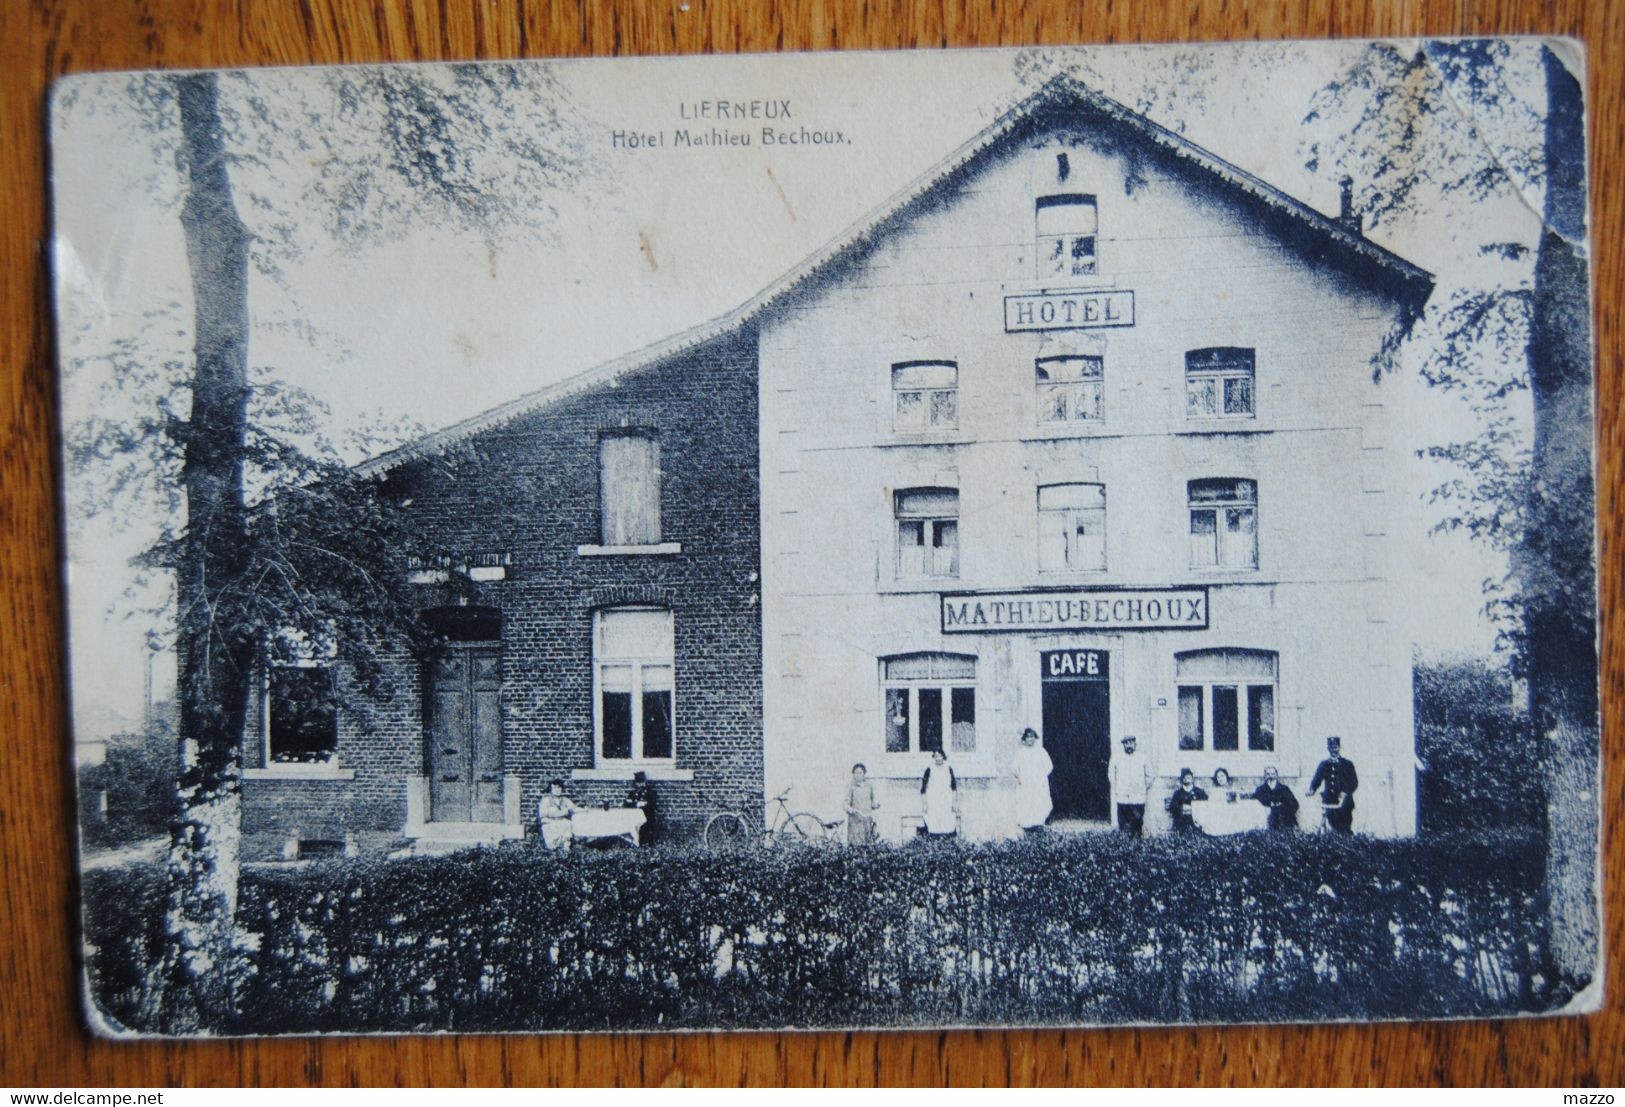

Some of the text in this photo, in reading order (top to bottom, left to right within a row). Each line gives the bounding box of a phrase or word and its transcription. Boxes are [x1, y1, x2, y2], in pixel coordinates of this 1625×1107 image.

[680, 100, 792, 119] LIERNEUX
[612, 129, 664, 149] Hôtel
[674, 128, 750, 147] Mathieu
[1016, 298, 1120, 324] HOTEL
[1050, 652, 1099, 676] CAFE
